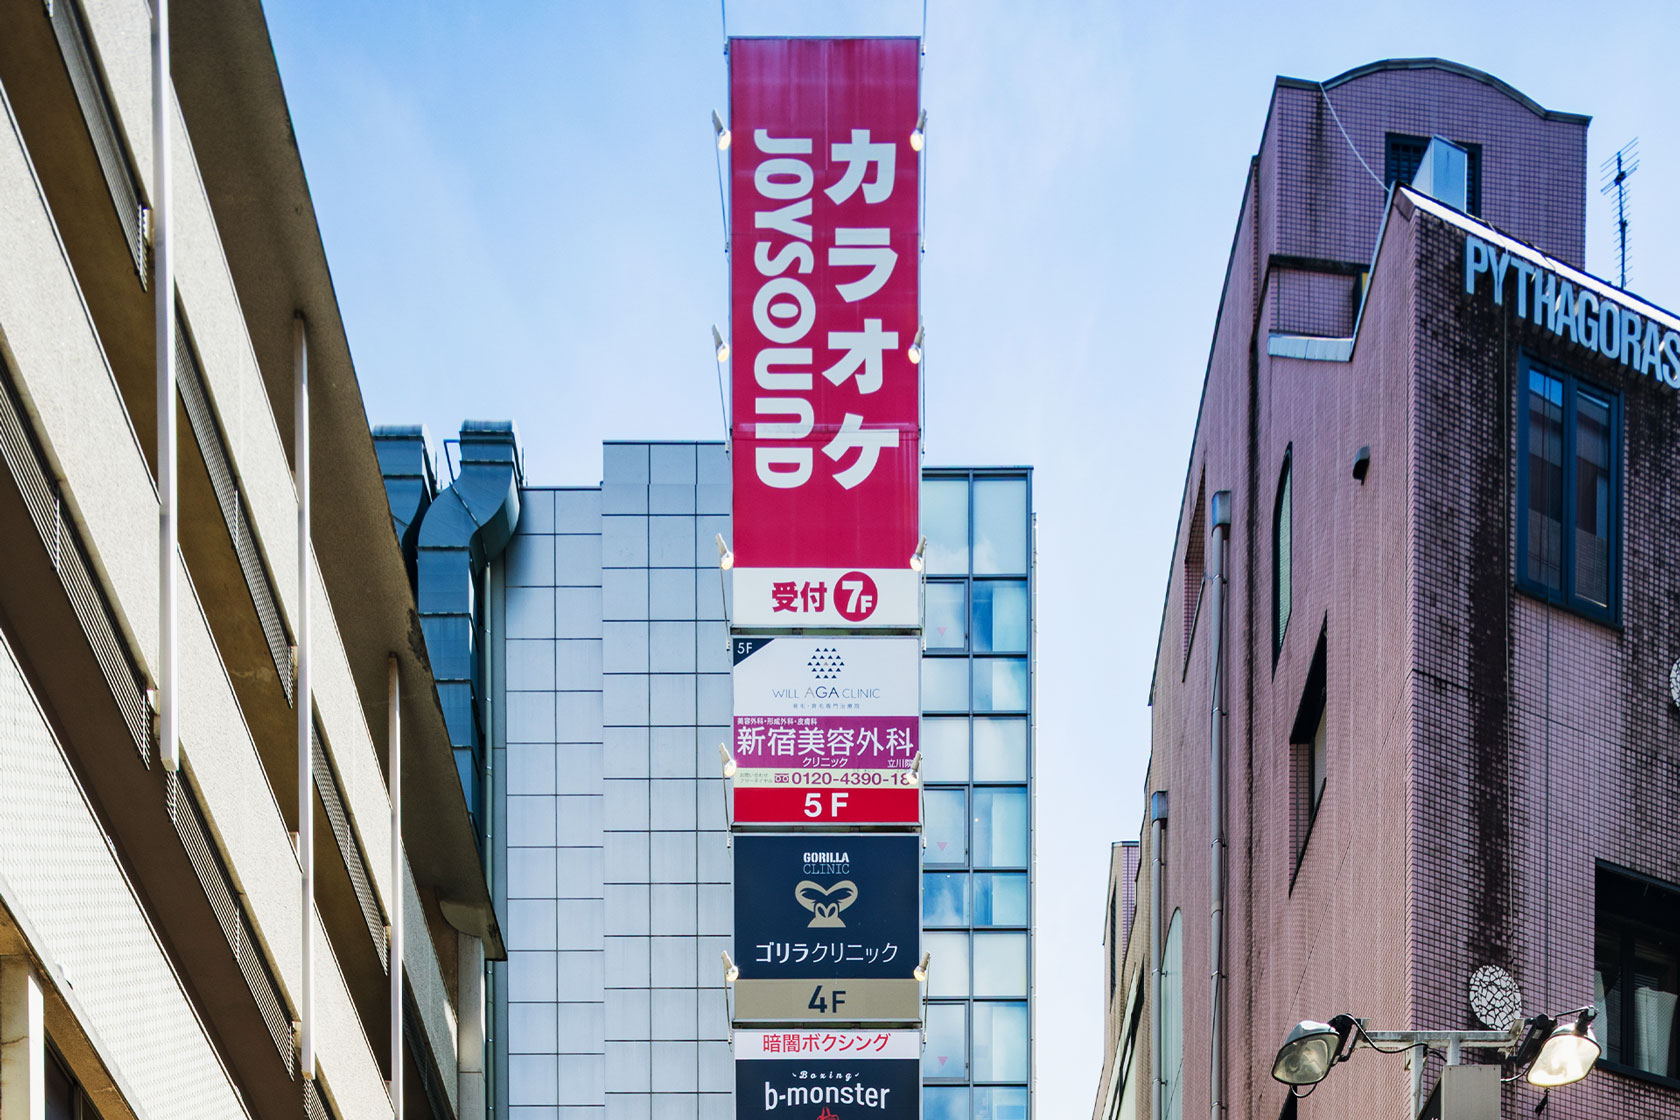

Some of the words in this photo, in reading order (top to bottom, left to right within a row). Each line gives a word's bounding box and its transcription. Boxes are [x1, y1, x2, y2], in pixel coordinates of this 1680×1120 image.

[753, 128, 816, 489] JOYSOUND
[821, 129, 900, 490] カラオケ
[1465, 235, 1680, 389] PYTHAGORAS
[771, 581, 827, 613] 受付
[842, 580, 873, 613] 7F
[737, 642, 753, 655] 5F
[771, 688, 800, 699] WILL
[804, 686, 840, 699] AGA
[842, 688, 881, 699] CLINIC
[737, 726, 914, 757] 新宿美容外科
[802, 757, 849, 768] クリニック
[803, 852, 850, 863] GORILLA
[803, 863, 850, 875] CLINIC
[755, 942, 898, 964] ゴリラクリニック
[808, 985, 846, 1013] 4F
[762, 1033, 891, 1053] 暗闇ボクシング
[799, 1070, 852, 1081] Boxing
[764, 1081, 890, 1111] b-monster
